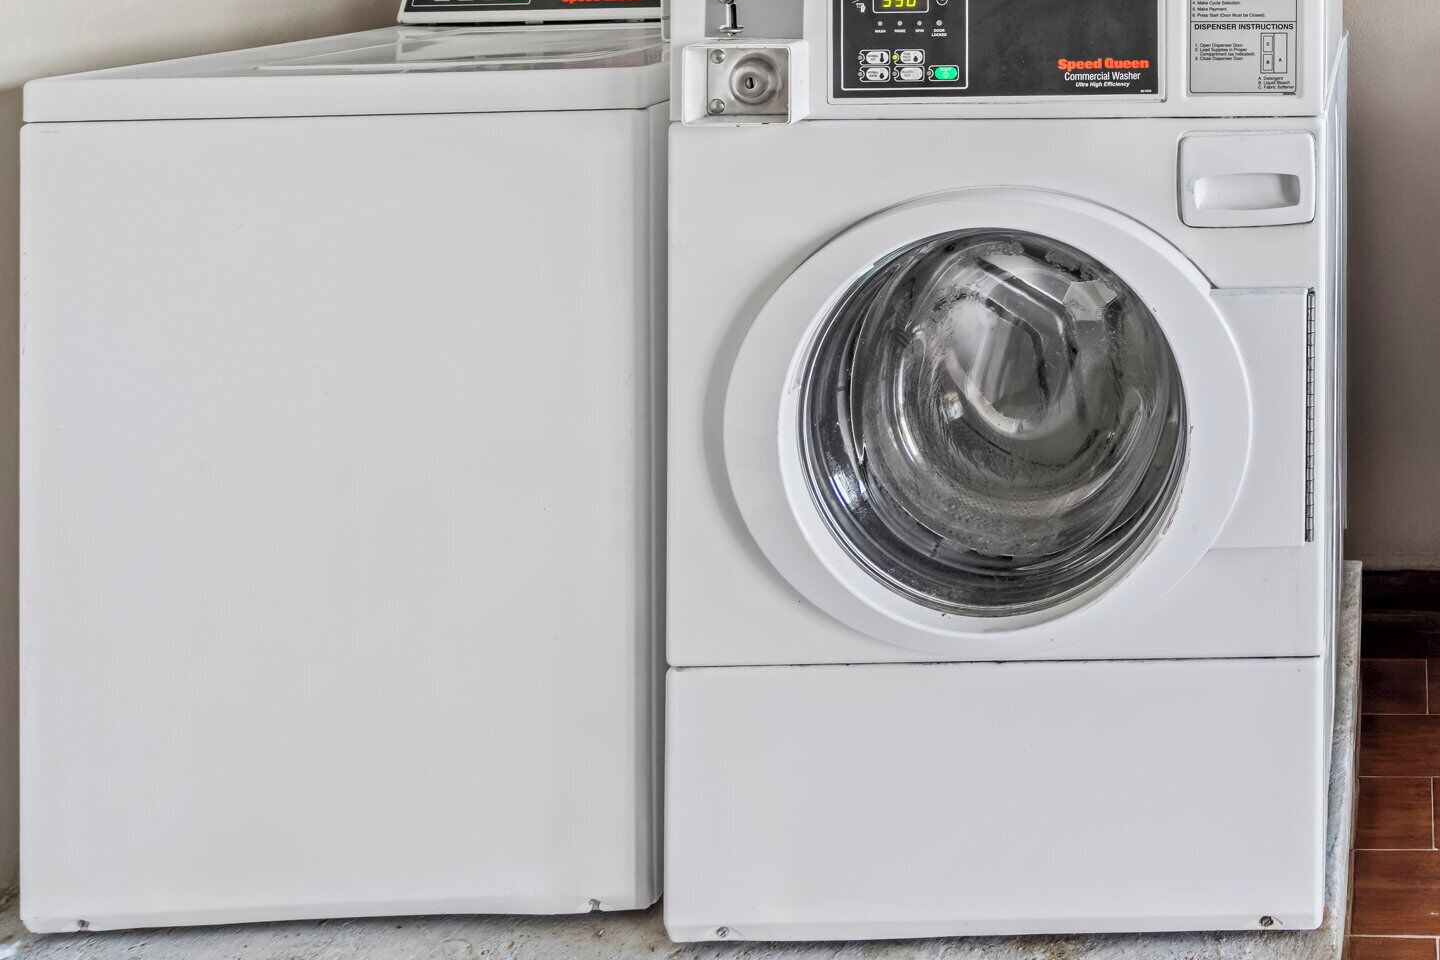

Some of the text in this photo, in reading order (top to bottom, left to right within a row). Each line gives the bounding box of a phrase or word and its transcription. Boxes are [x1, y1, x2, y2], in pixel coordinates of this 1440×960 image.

[1057, 58, 1150, 72] Speed Queen
[1064, 72, 1141, 81] Commercial Washer
